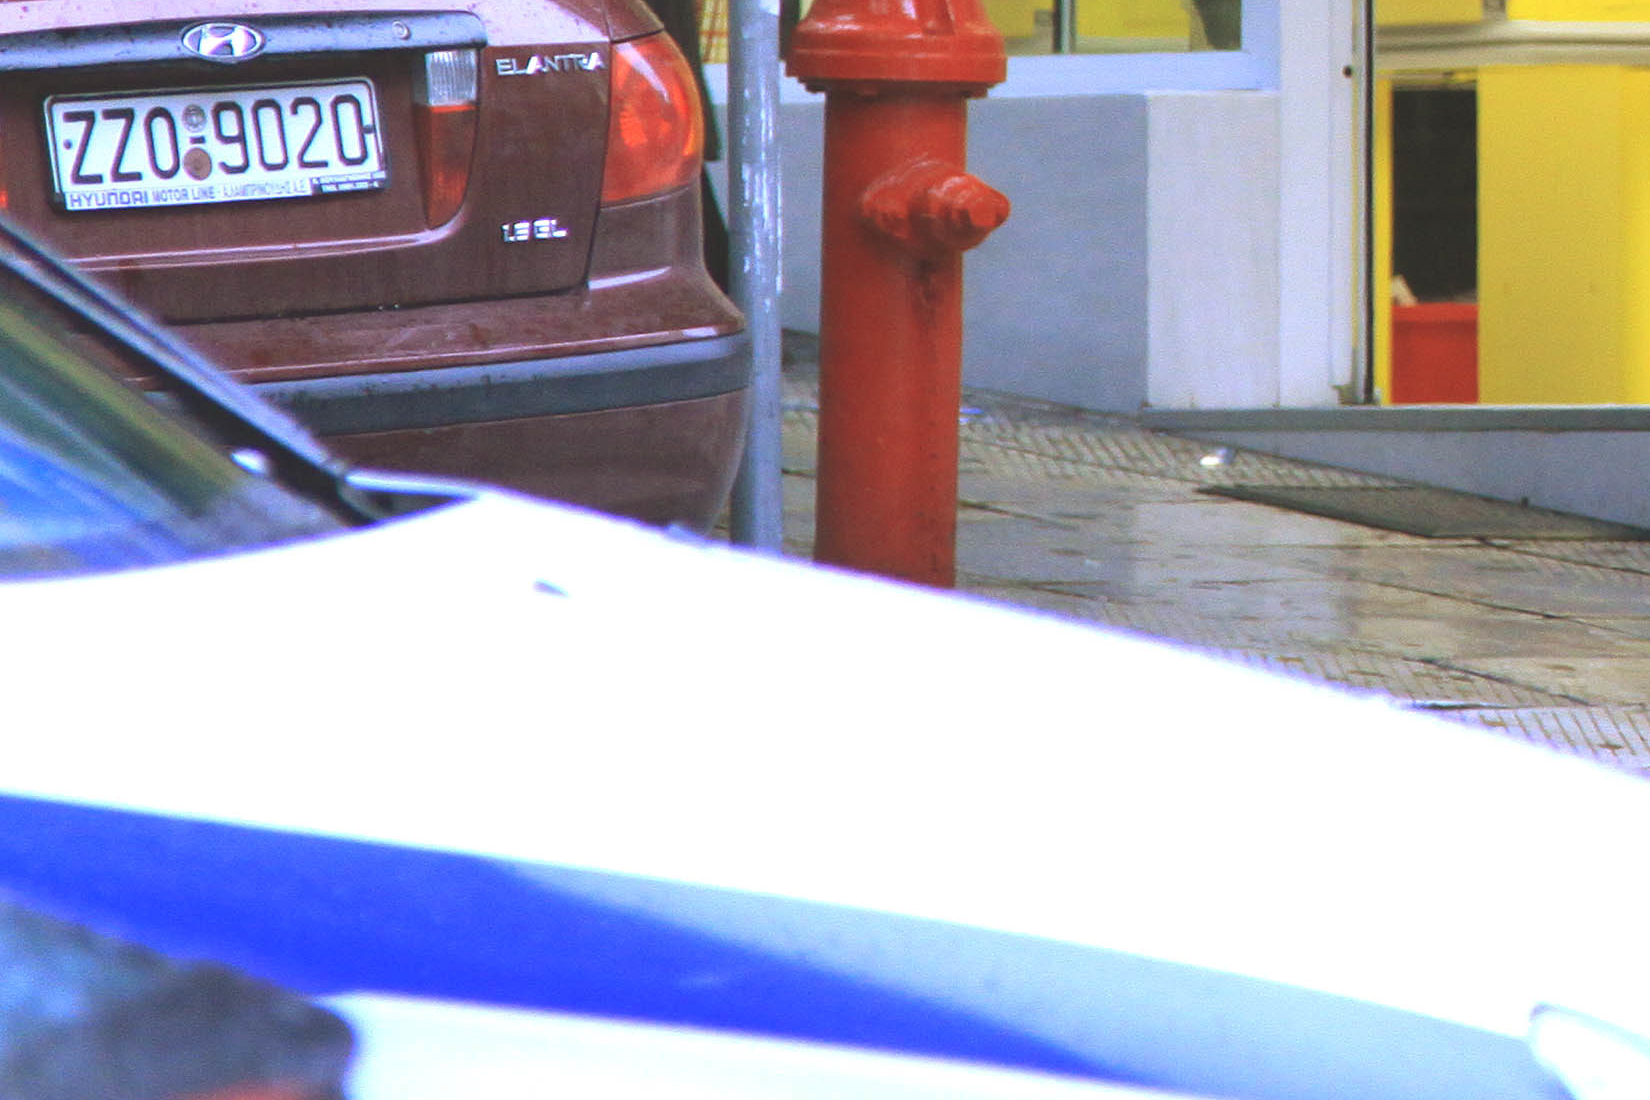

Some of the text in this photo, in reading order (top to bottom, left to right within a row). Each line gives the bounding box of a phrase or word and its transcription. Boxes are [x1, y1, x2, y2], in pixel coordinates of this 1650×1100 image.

[496, 51, 605, 76] ELANTRA
[152, 187, 189, 203] MOTOR
[191, 185, 216, 201] LINE
